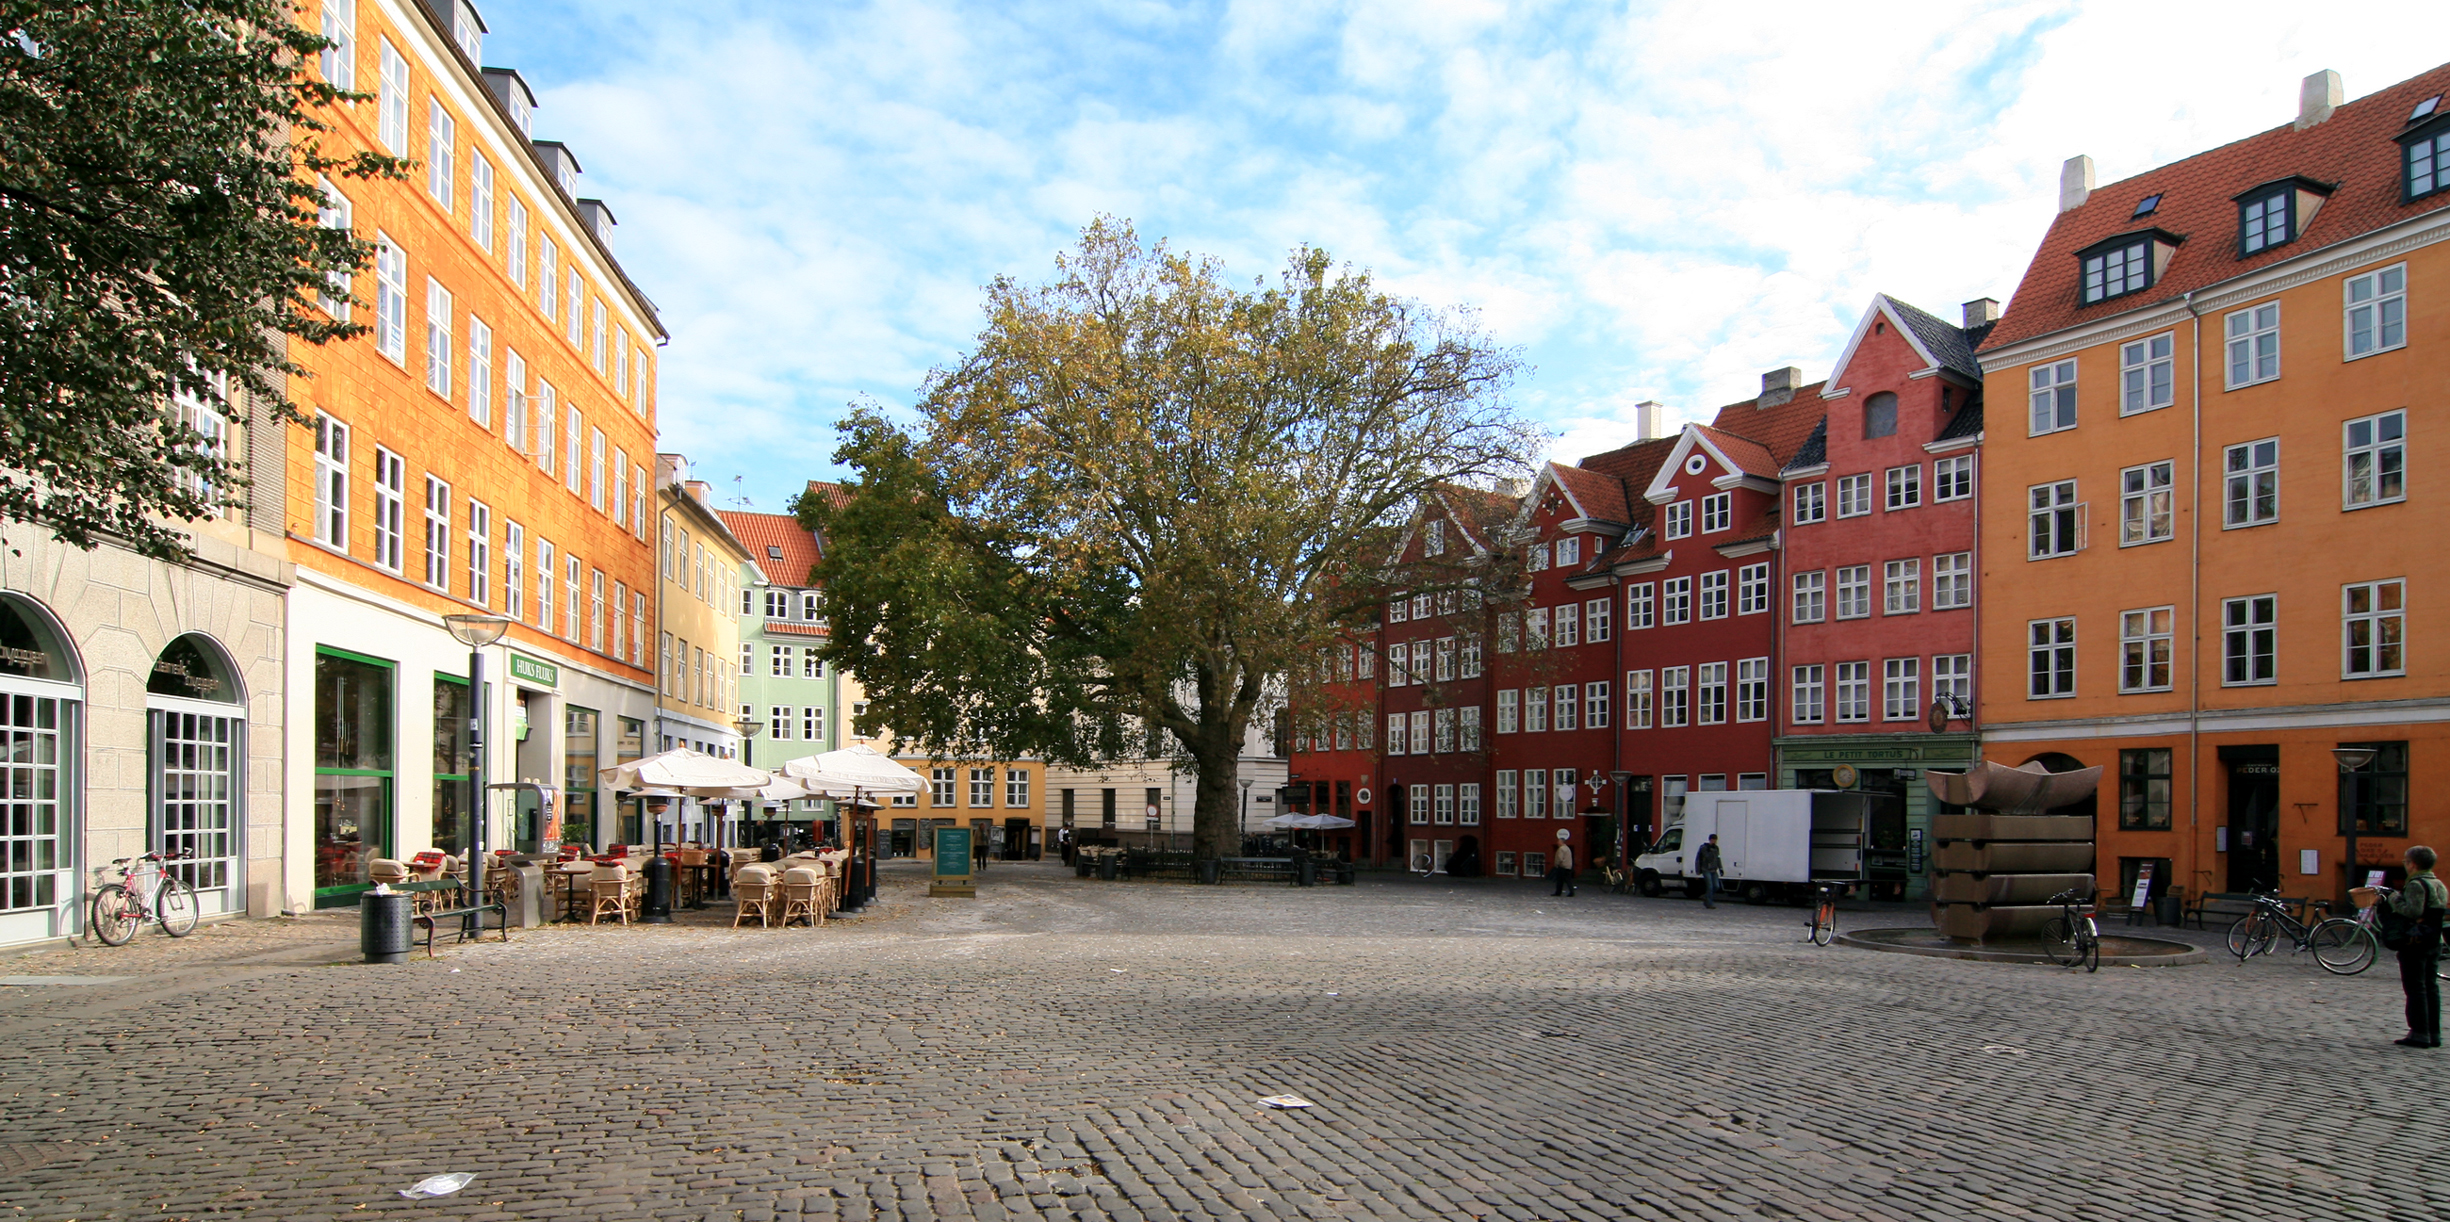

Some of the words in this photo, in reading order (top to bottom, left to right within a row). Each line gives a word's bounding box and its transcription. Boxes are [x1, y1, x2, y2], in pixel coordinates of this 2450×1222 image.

[516, 658, 535, 677] HUKS
[535, 664, 554, 683] FLUKS
[1824, 751, 1835, 759] LE
[1839, 751, 1863, 759] PETIT
[2236, 766, 2267, 774] PEDER
